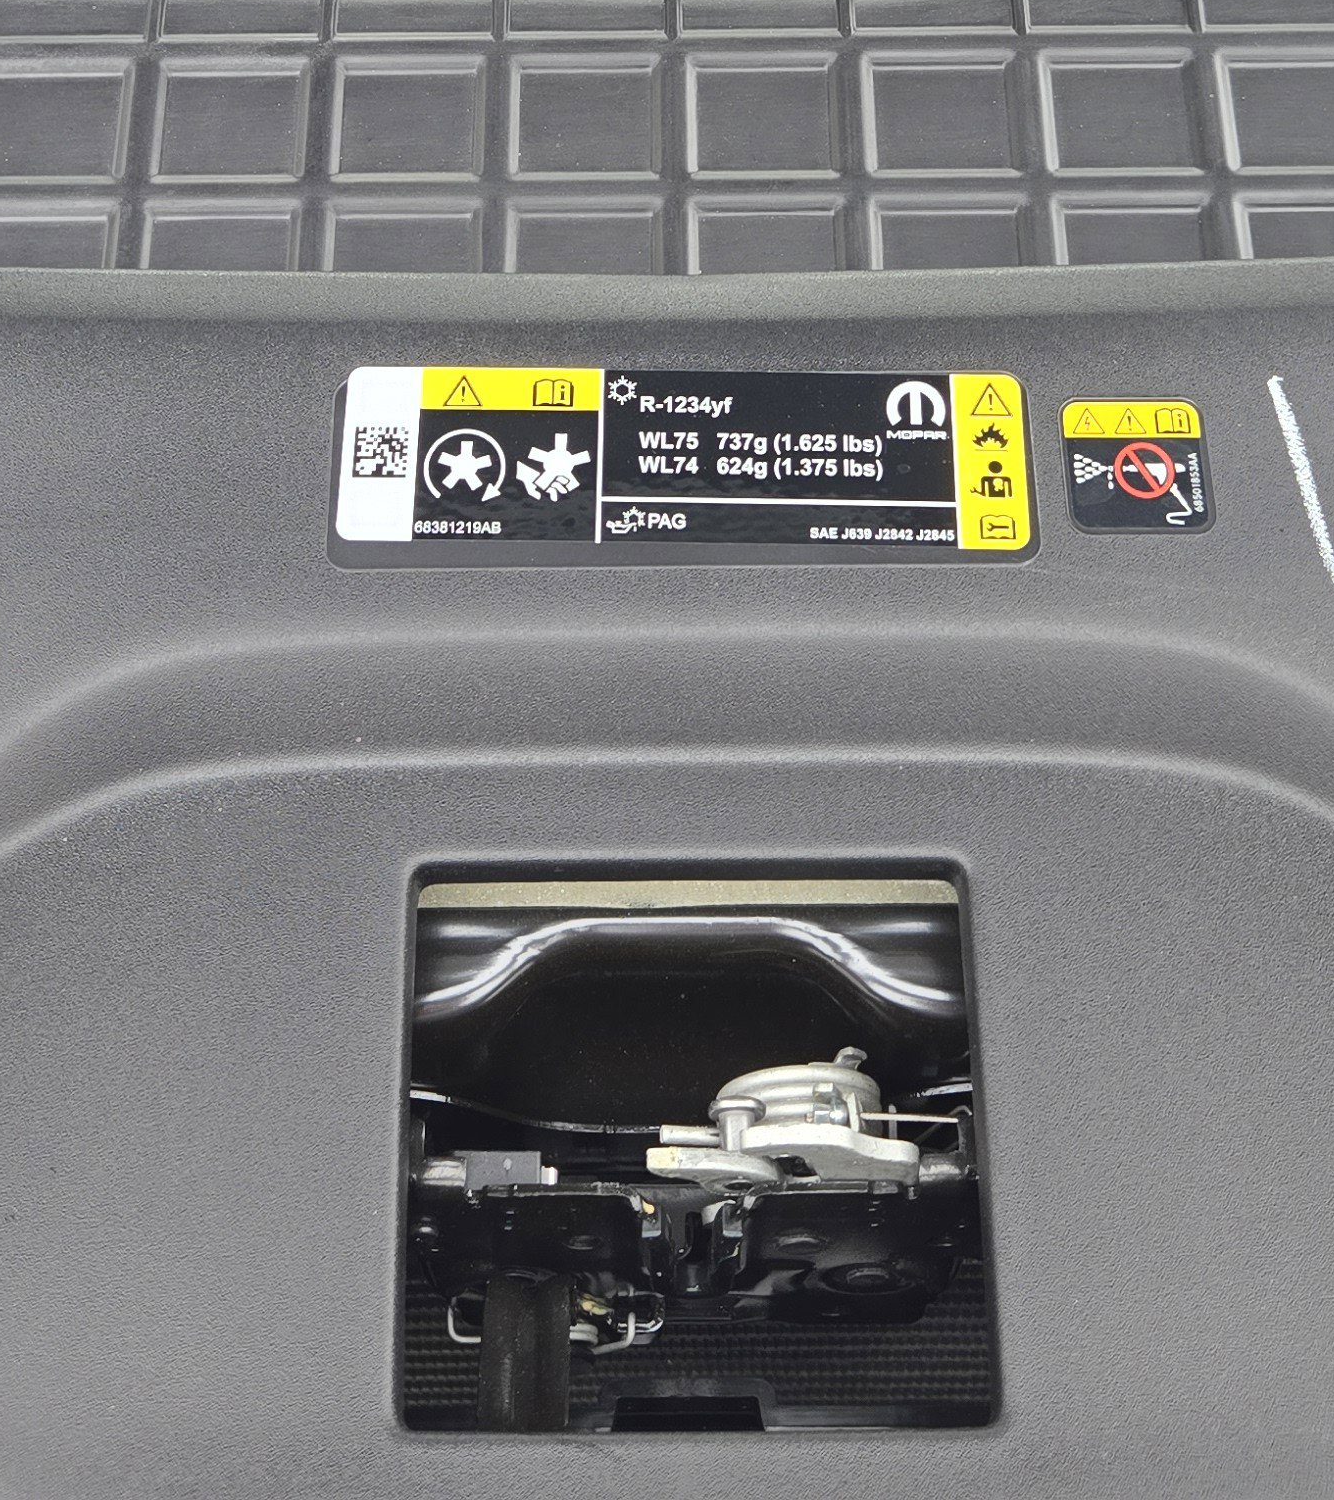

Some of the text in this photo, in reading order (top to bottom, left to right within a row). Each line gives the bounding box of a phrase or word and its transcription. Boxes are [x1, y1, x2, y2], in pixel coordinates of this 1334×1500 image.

[639, 396, 733, 418] R-1234yf
[638, 431, 883, 457] WL75 737g (1.625 lbs)
[886, 430, 947, 440] MOPAR
[638, 456, 884, 481] WL74 624g (1.375 lbs)
[413, 520, 502, 535] 68381219AB
[647, 512, 687, 530] PAG
[809, 526, 955, 542] SAE J639 J2842 J2845
